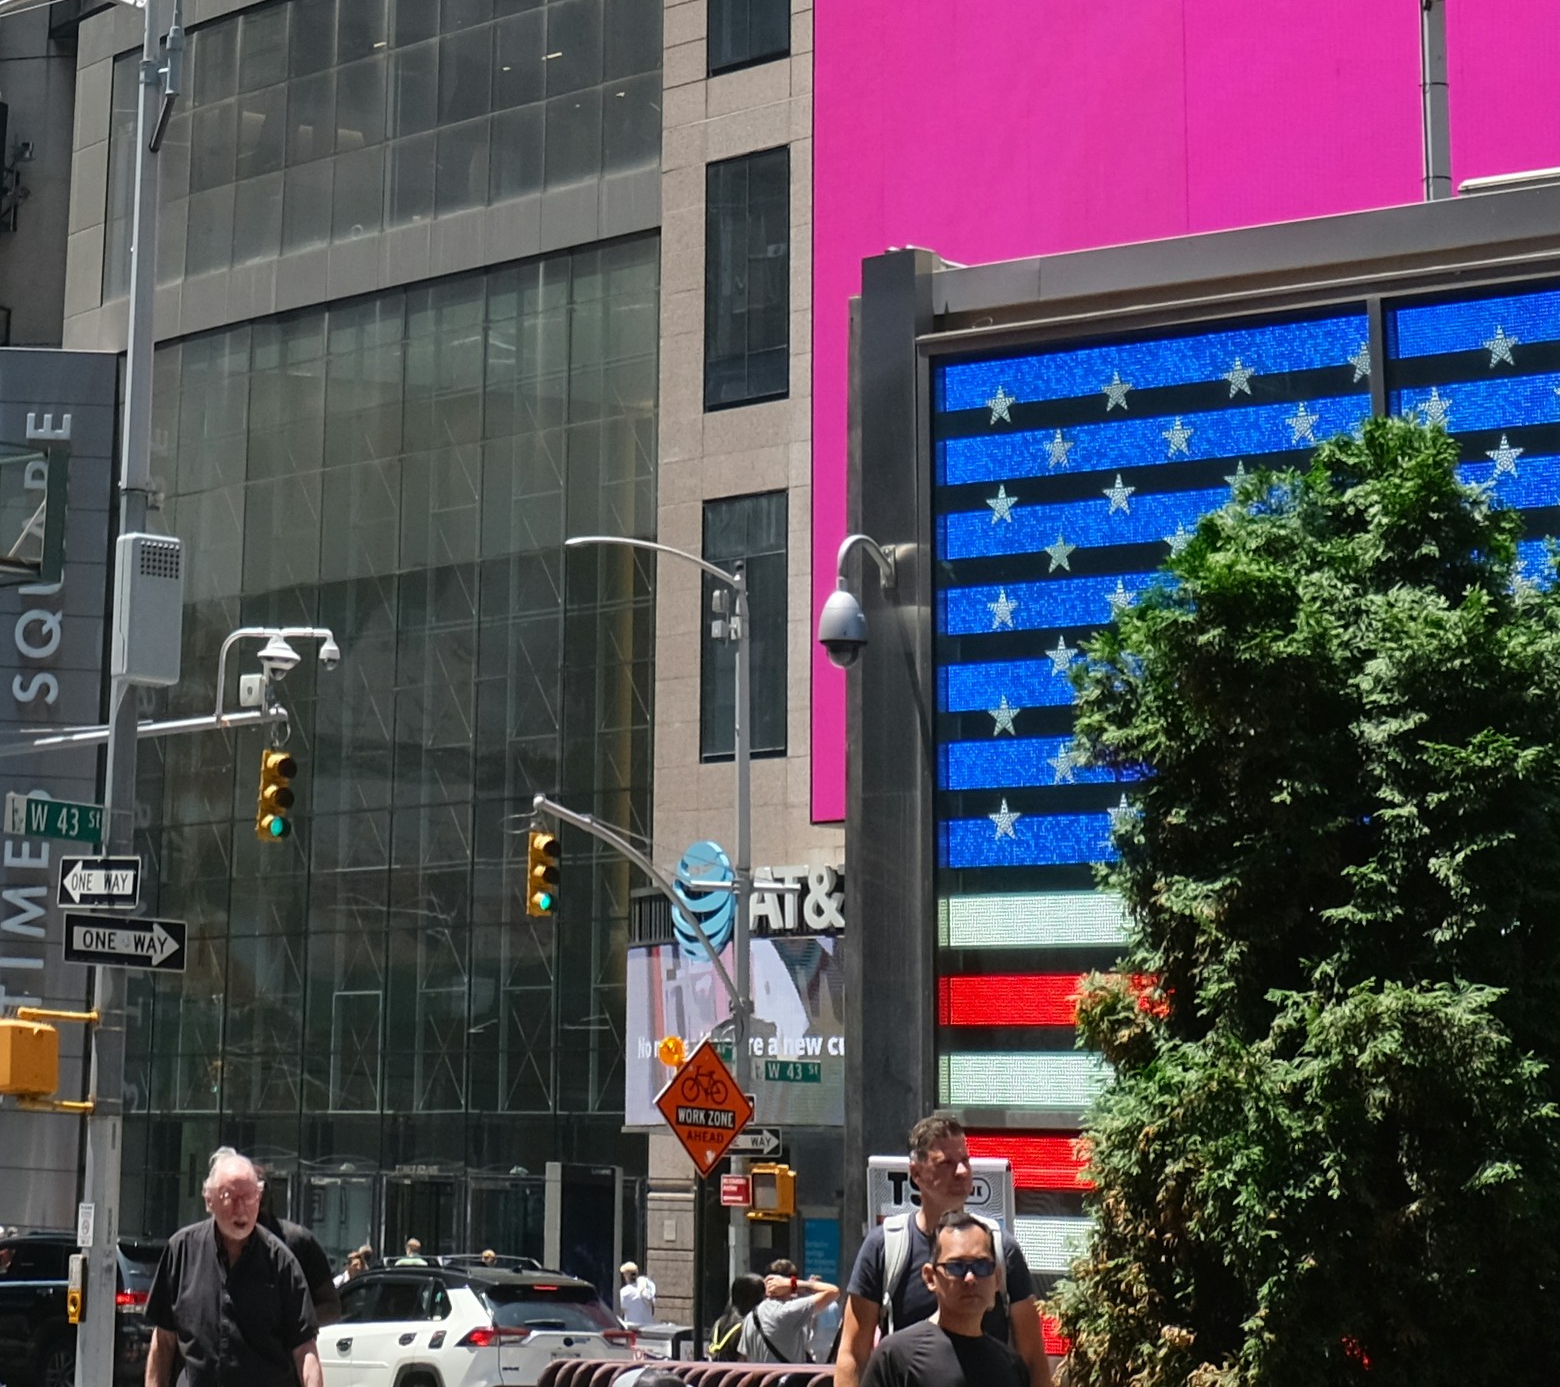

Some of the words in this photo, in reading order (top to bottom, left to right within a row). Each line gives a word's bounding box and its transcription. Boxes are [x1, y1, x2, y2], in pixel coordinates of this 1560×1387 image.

[31, 803, 49, 832] W
[57, 807, 80, 837] 43
[88, 811, 101, 829] St
[71, 872, 94, 892] ONE
[103, 872, 129, 892] WAY
[83, 930, 117, 951] ONE
[133, 933, 169, 956] WAY
[637, 1036, 653, 1059] No
[768, 1038, 778, 1057] a
[783, 1036, 823, 1057] new
[767, 1062, 780, 1080] W
[786, 1063, 803, 1080] 43
[677, 1108, 706, 1125] WORK
[707, 1111, 735, 1128] ZONE
[686, 1130, 725, 1145] AHEAD
[750, 1136, 772, 1148] WAY
